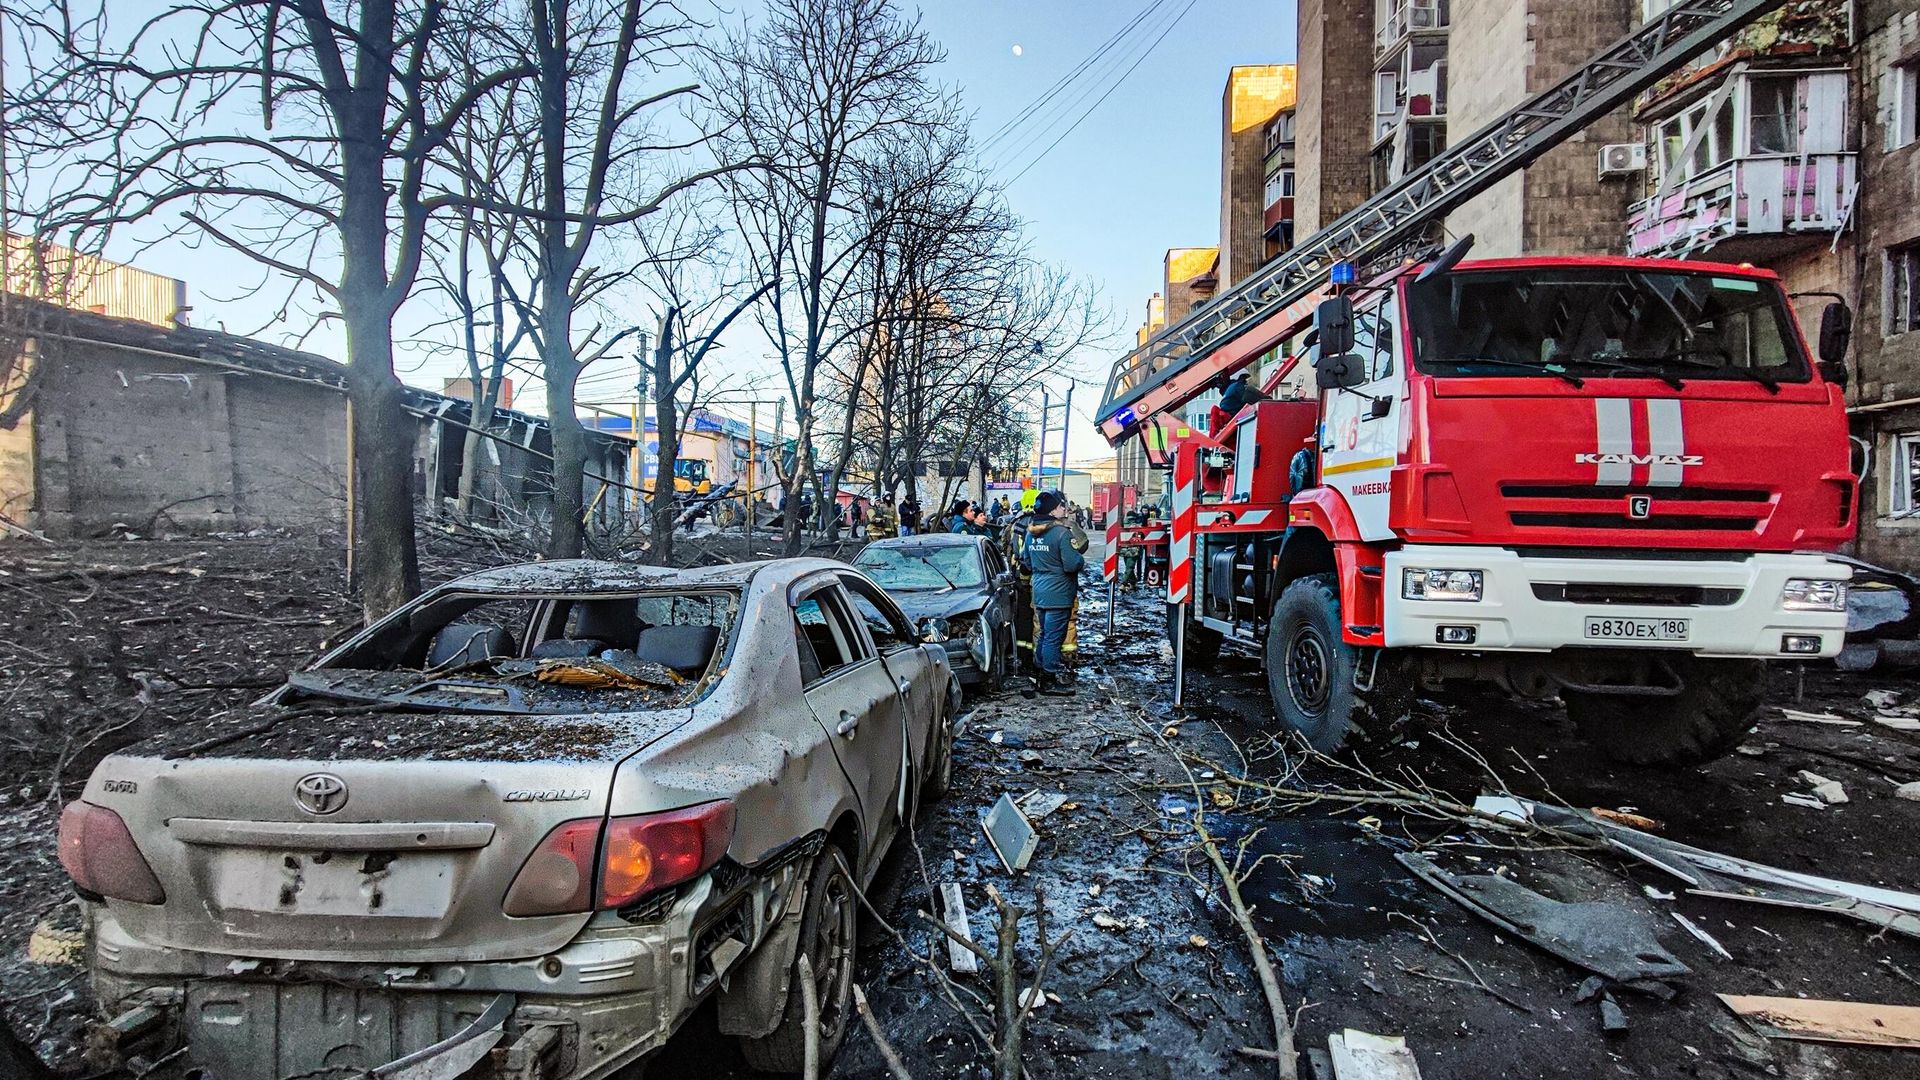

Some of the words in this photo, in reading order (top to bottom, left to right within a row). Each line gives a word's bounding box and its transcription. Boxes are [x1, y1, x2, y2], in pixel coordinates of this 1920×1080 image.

[1575, 453, 1704, 466] KAMAZ
[1148, 569, 1159, 585] 9
[1661, 621, 1685, 634] 180
[503, 789, 592, 802] COROLLA
